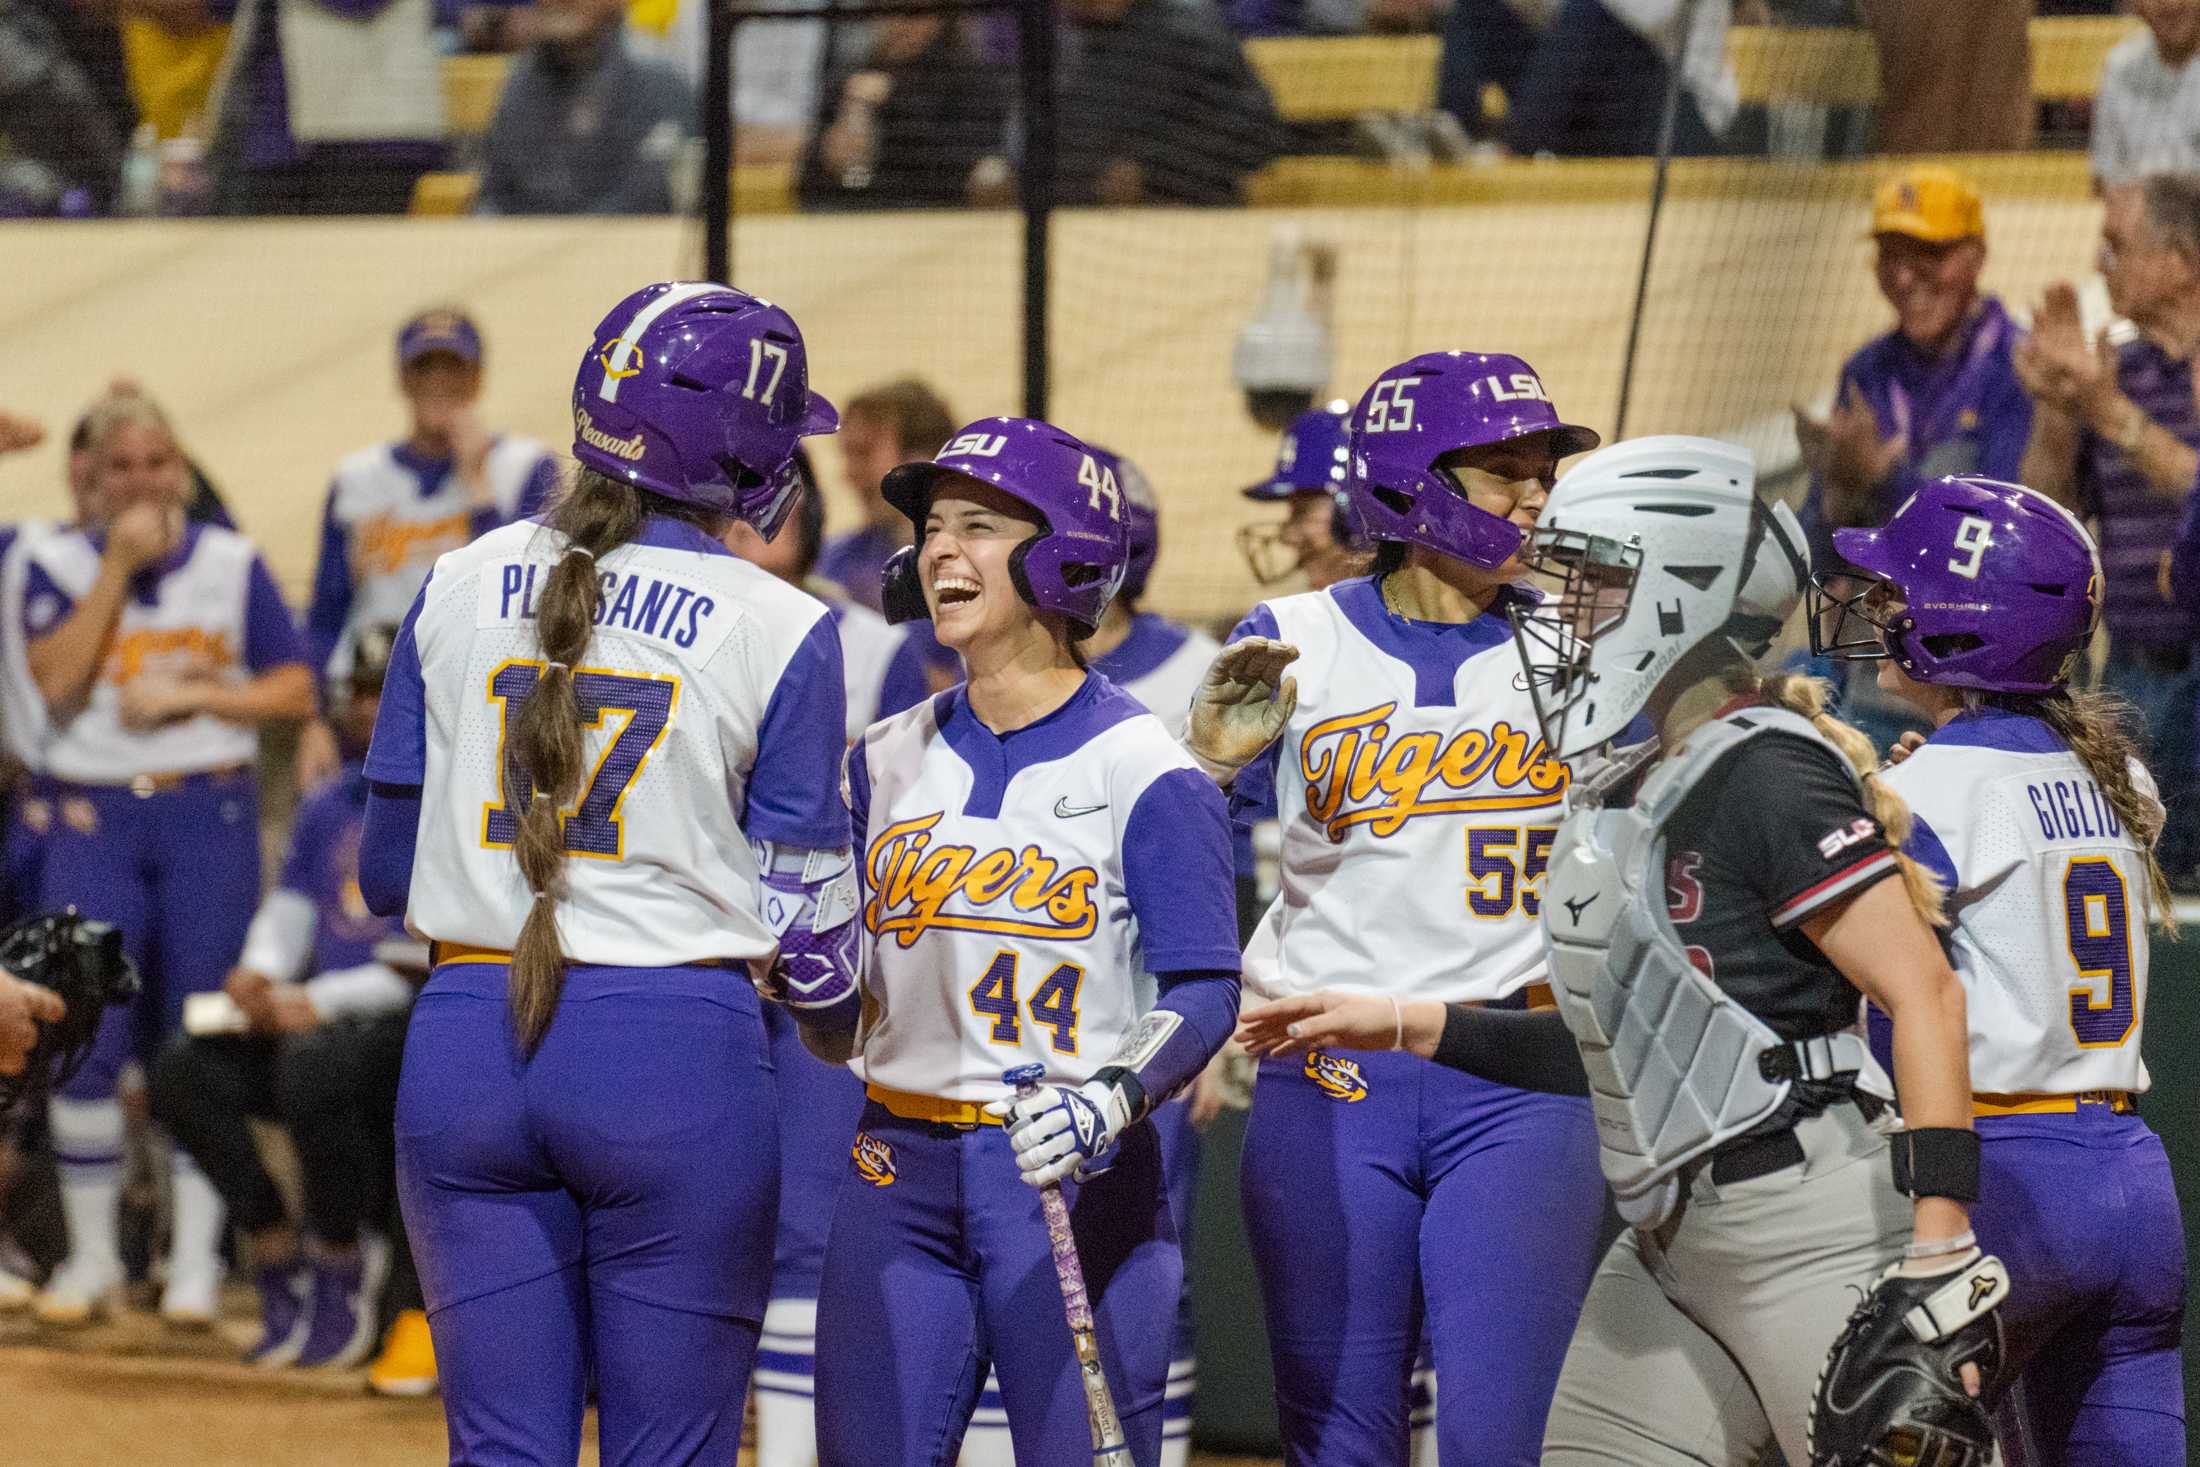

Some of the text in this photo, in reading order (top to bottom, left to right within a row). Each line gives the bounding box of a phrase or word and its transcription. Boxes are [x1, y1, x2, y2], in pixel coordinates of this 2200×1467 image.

[742, 338, 787, 406] 17
[1366, 377, 1422, 433] 55
[576, 408, 646, 460] Pleasants
[934, 433, 1008, 462] LSU
[1078, 454, 1120, 523] 44
[1948, 516, 1993, 580] 9
[500, 563, 715, 649] PLSANTS
[480, 657, 682, 863] 17
[1300, 700, 1573, 845] Tigers
[864, 810, 1099, 949] Tigers
[2062, 855, 2138, 1048] 9
[967, 949, 1087, 1057] 44
